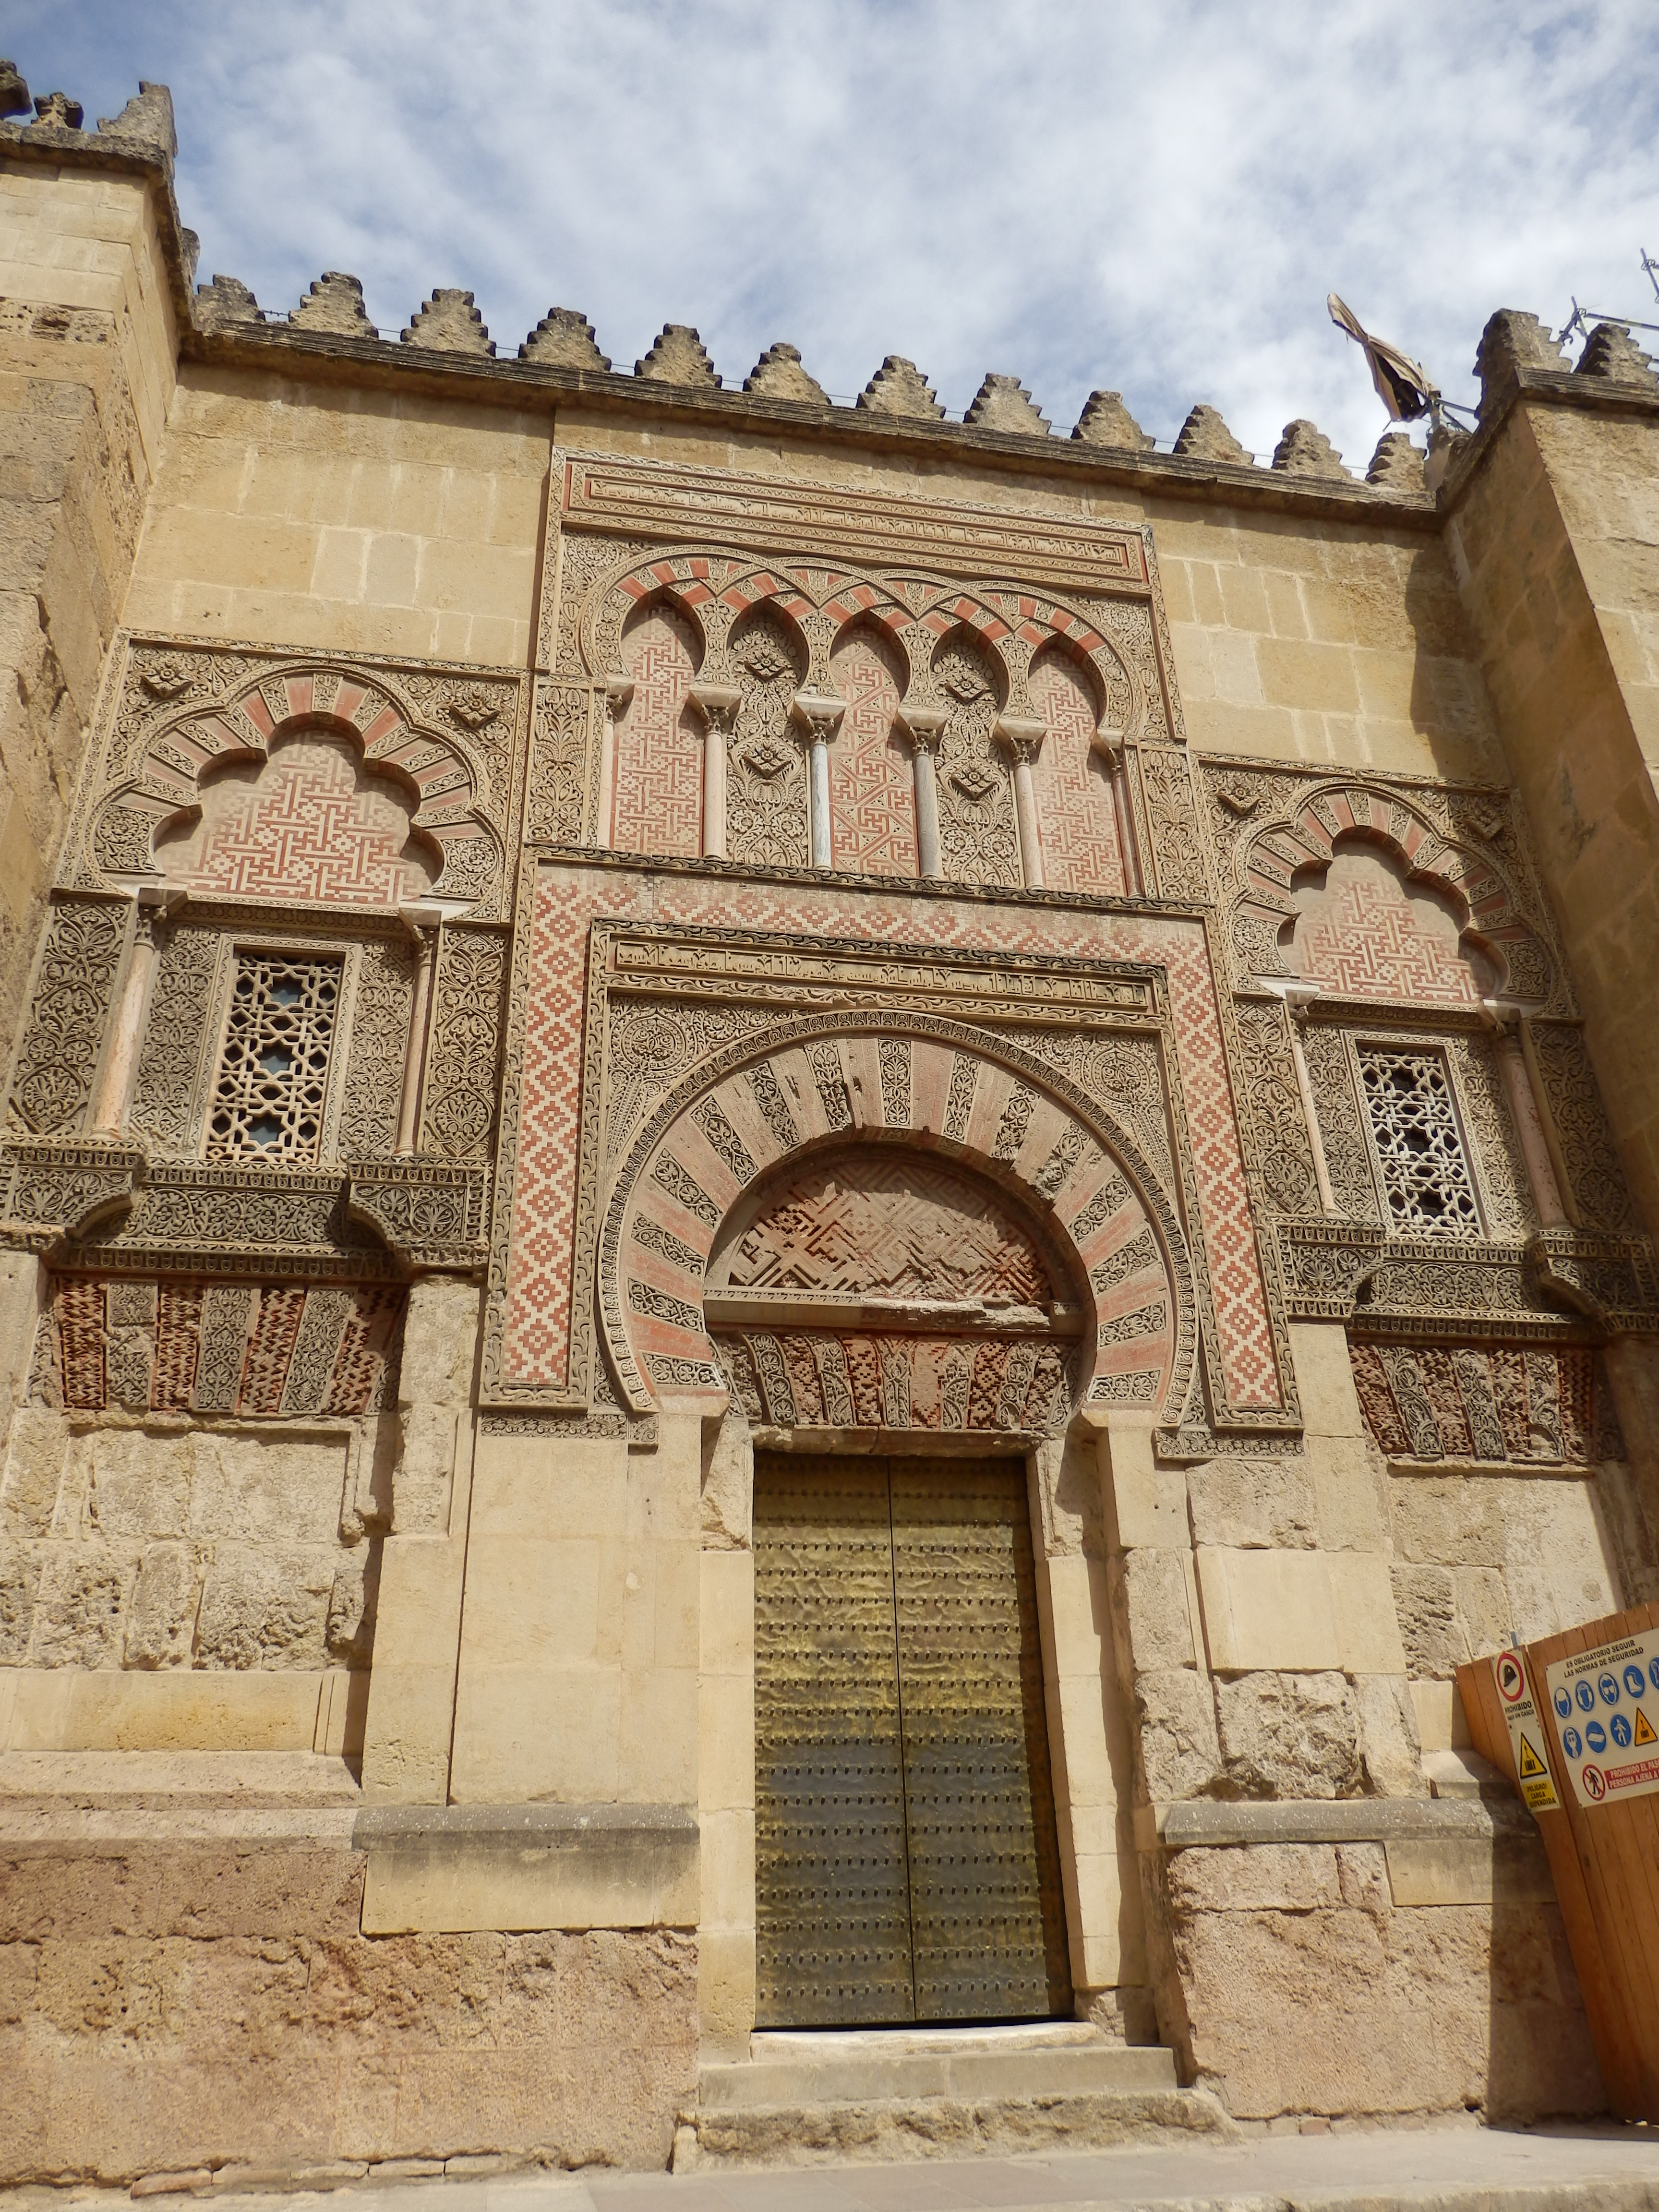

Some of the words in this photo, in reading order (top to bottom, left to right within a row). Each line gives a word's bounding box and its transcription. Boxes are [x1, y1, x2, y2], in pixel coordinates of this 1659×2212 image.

[1574, 1648, 1611, 1665] OBLIGATORIO
[1611, 1640, 1635, 1652] SEGUIR
[1564, 1670, 1575, 1678] LAS
[1575, 1661, 1598, 1674] NORMAS
[1599, 1658, 1607, 1666] DE
[1609, 1647, 1644, 1663] SEGURIDAD
[1609, 1776, 1635, 1789] PERSONA
[1635, 1771, 1653, 1783] AJENA
[1654, 1770, 1659, 1779] A
[1610, 1765, 1640, 1779] PROHIBIDO
[1640, 1763, 1648, 1772] EL
[1531, 1791, 1546, 1799] CARGA
